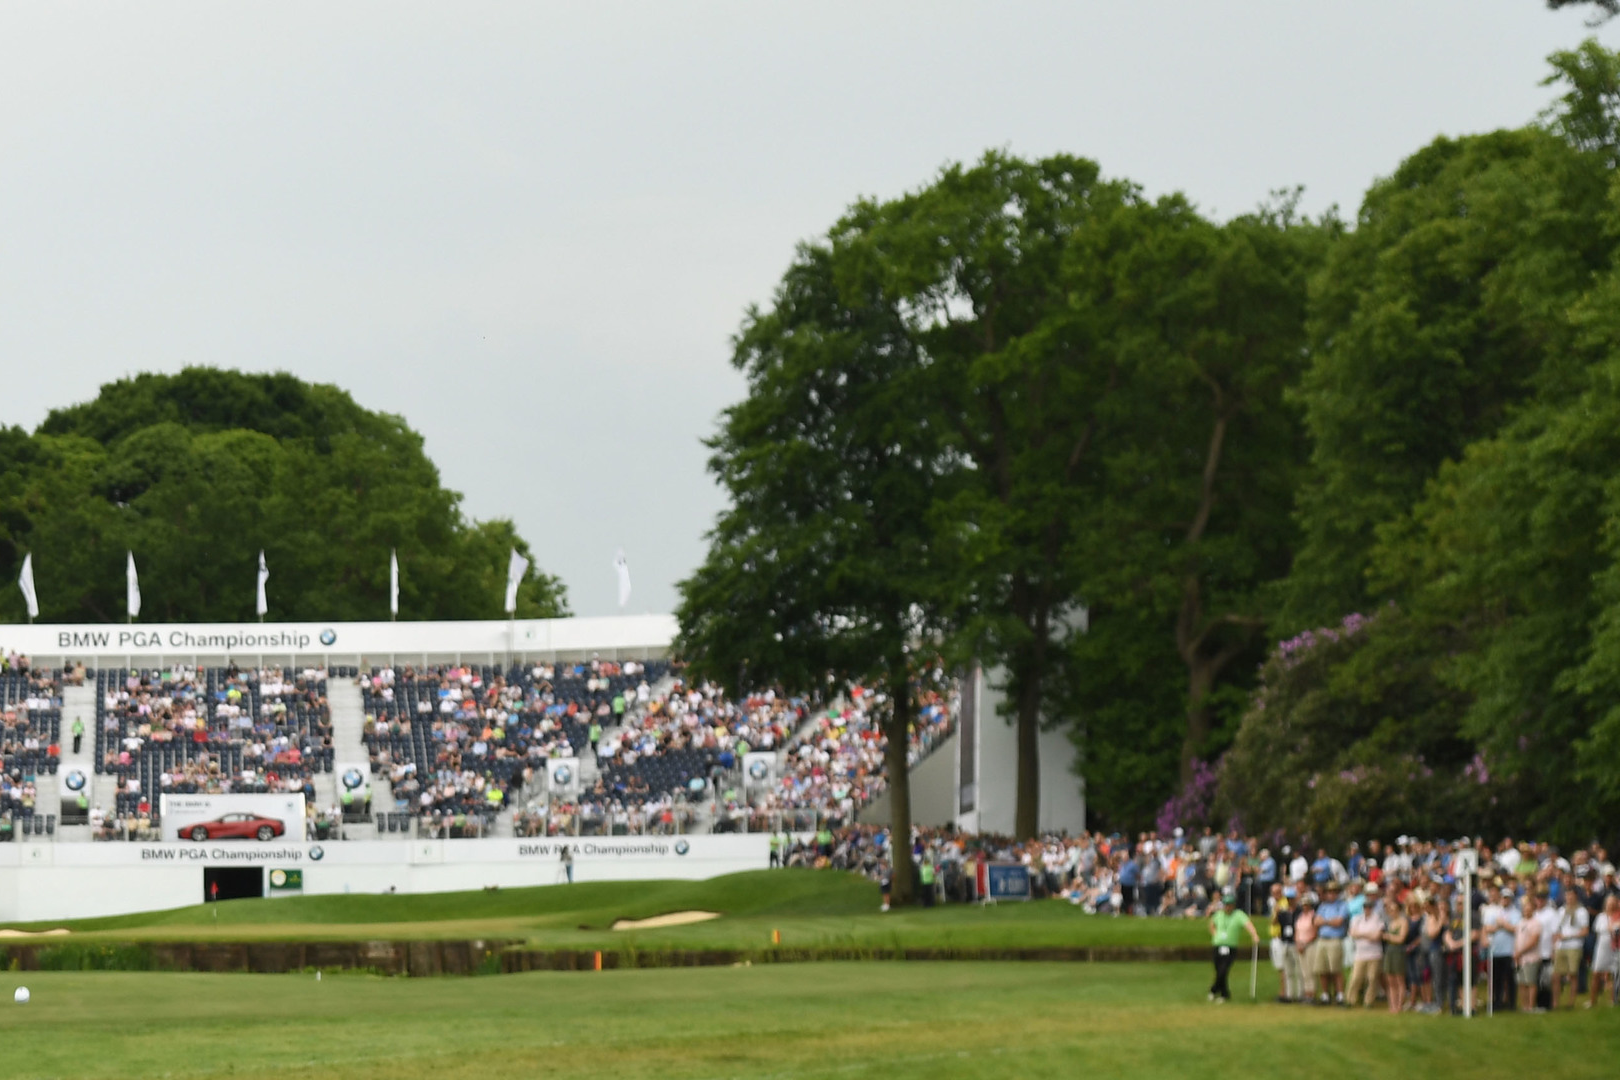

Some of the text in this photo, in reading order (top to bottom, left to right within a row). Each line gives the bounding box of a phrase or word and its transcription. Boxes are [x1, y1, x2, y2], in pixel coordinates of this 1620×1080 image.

[58, 630, 311, 650] BMW PGA Championship
[141, 848, 302, 861] BMW PGA Championship
[519, 843, 670, 856] BMW PA Championship
